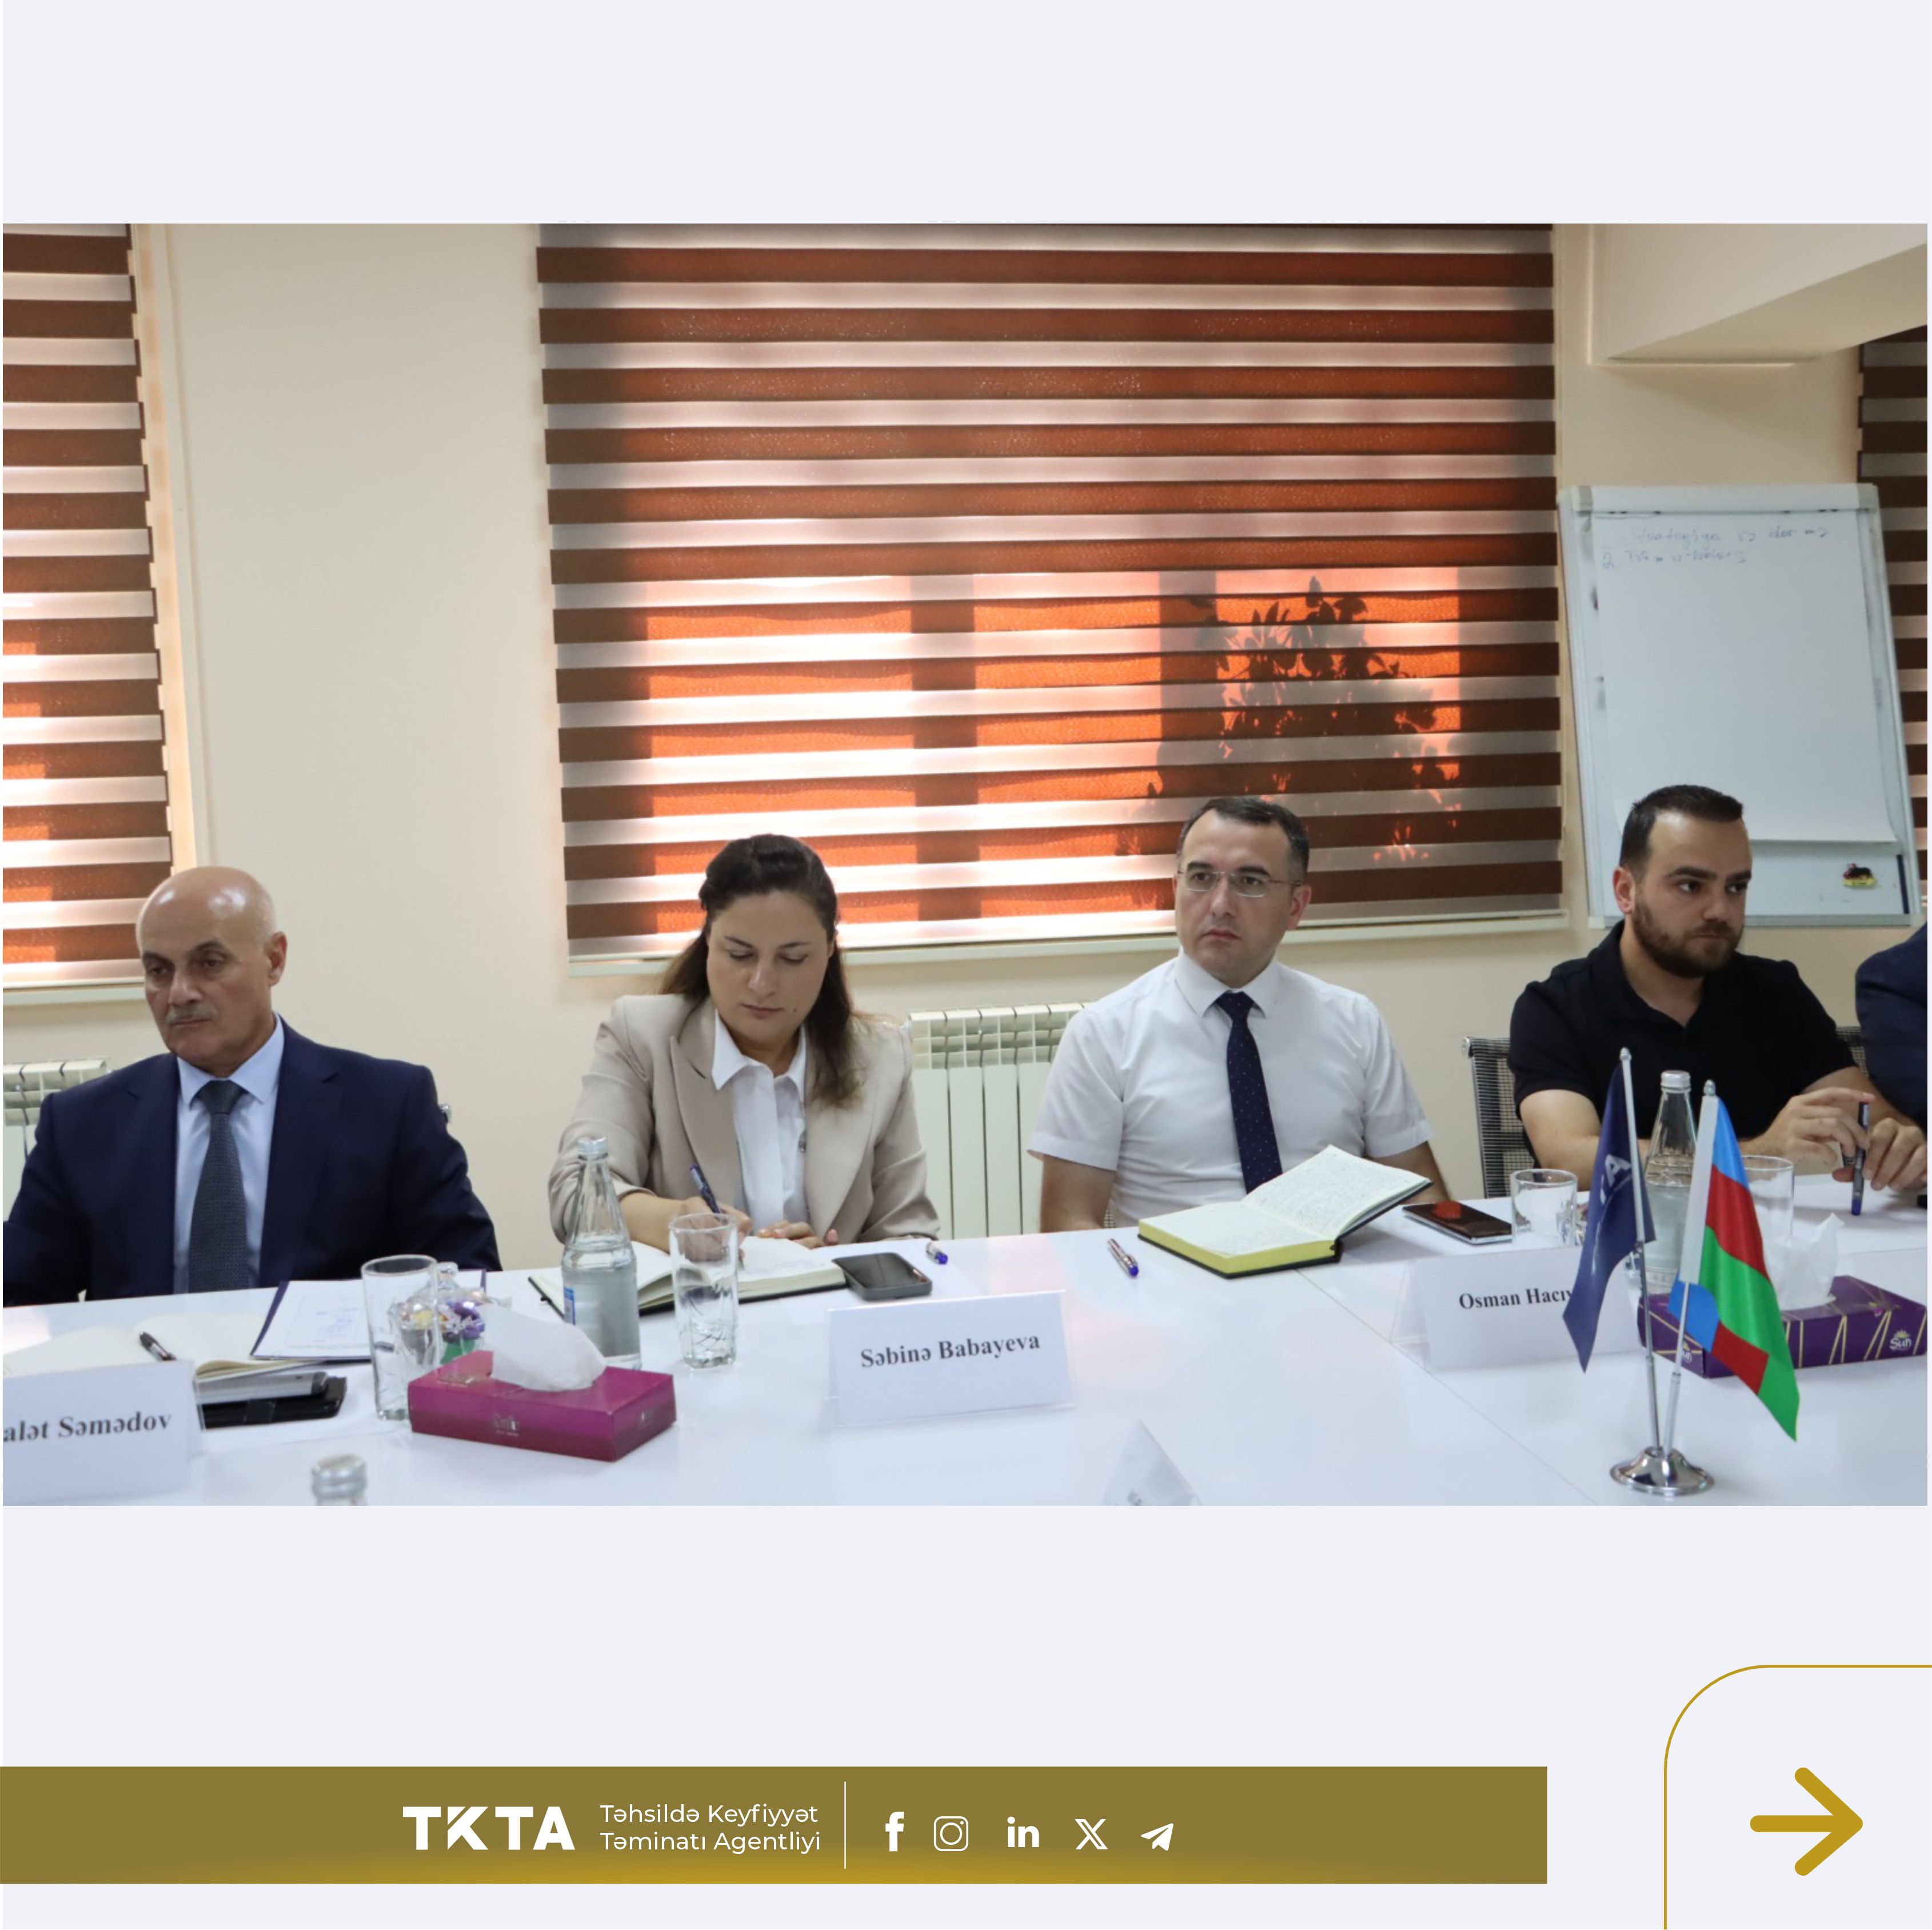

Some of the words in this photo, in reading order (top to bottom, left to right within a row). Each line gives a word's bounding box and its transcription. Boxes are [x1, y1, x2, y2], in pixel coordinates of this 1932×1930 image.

[1459, 1293, 1521, 1309] Osman
[860, 1345, 931, 1368] Səbinə
[938, 1335, 1040, 1359] Babayeva
[1889, 1337, 1912, 1351] Sun
[58, 1411, 171, 1438] Səmədov
